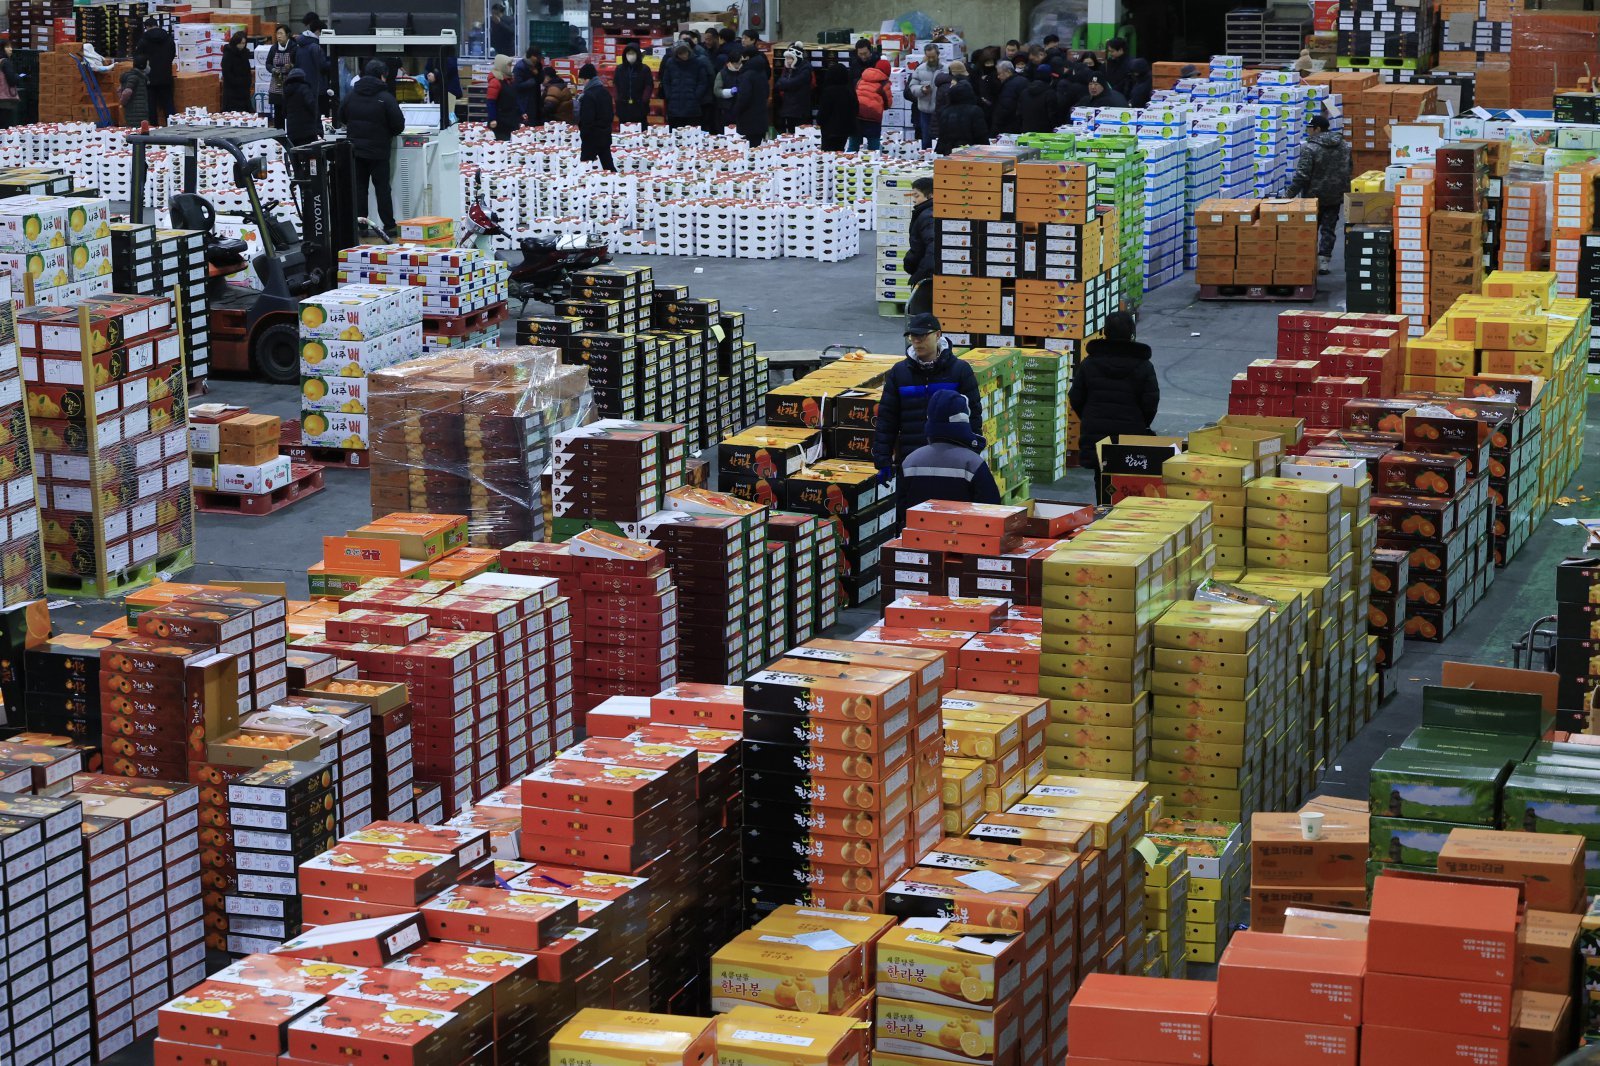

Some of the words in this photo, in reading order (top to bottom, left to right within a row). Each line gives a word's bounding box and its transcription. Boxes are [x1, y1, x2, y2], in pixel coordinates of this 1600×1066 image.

[89, 212, 98, 222] 나주
[99, 206, 107, 220] 배
[314, 194, 322, 236] TOYOTA
[43, 221, 53, 230] 나주
[54, 216, 61, 230] 배
[91, 250, 100, 258] 나주
[101, 243, 109, 257] 배
[47, 260, 56, 268] 나주
[57, 254, 64, 268] 배
[347, 312, 359, 325] 배
[331, 351, 346, 359] 나주
[348, 348, 360, 362] 배
[332, 387, 347, 395] 나주
[348, 384, 360, 398] 배
[332, 423, 347, 431] 나주
[349, 421, 360, 434] 배
[1125, 454, 1148, 469] 한라봉
[362, 550, 381, 560] 감귤
[170, 624, 191, 633] 레드향
[133, 659, 155, 669] 레드향
[132, 680, 154, 690] 레드향
[134, 701, 156, 711] 레드향
[794, 696, 824, 712] 한라봉
[134, 721, 156, 731] 레드향
[793, 726, 824, 742] 한라봉
[136, 743, 158, 752] 레드향
[138, 764, 159, 773] 레드향
[793, 755, 825, 771] 한라봉
[795, 785, 826, 800] 한라봉
[794, 812, 825, 828] 한라봉
[793, 841, 824, 857] 한라봉
[793, 869, 824, 884] 한라봉
[887, 957, 914, 966] 새콤달콤
[721, 971, 749, 981] 새콤달콤
[888, 965, 927, 982] 한라봉
[722, 980, 761, 996] 한라봉
[886, 1012, 914, 1022] 새콤달콤
[886, 1020, 926, 1038] 한라봉
